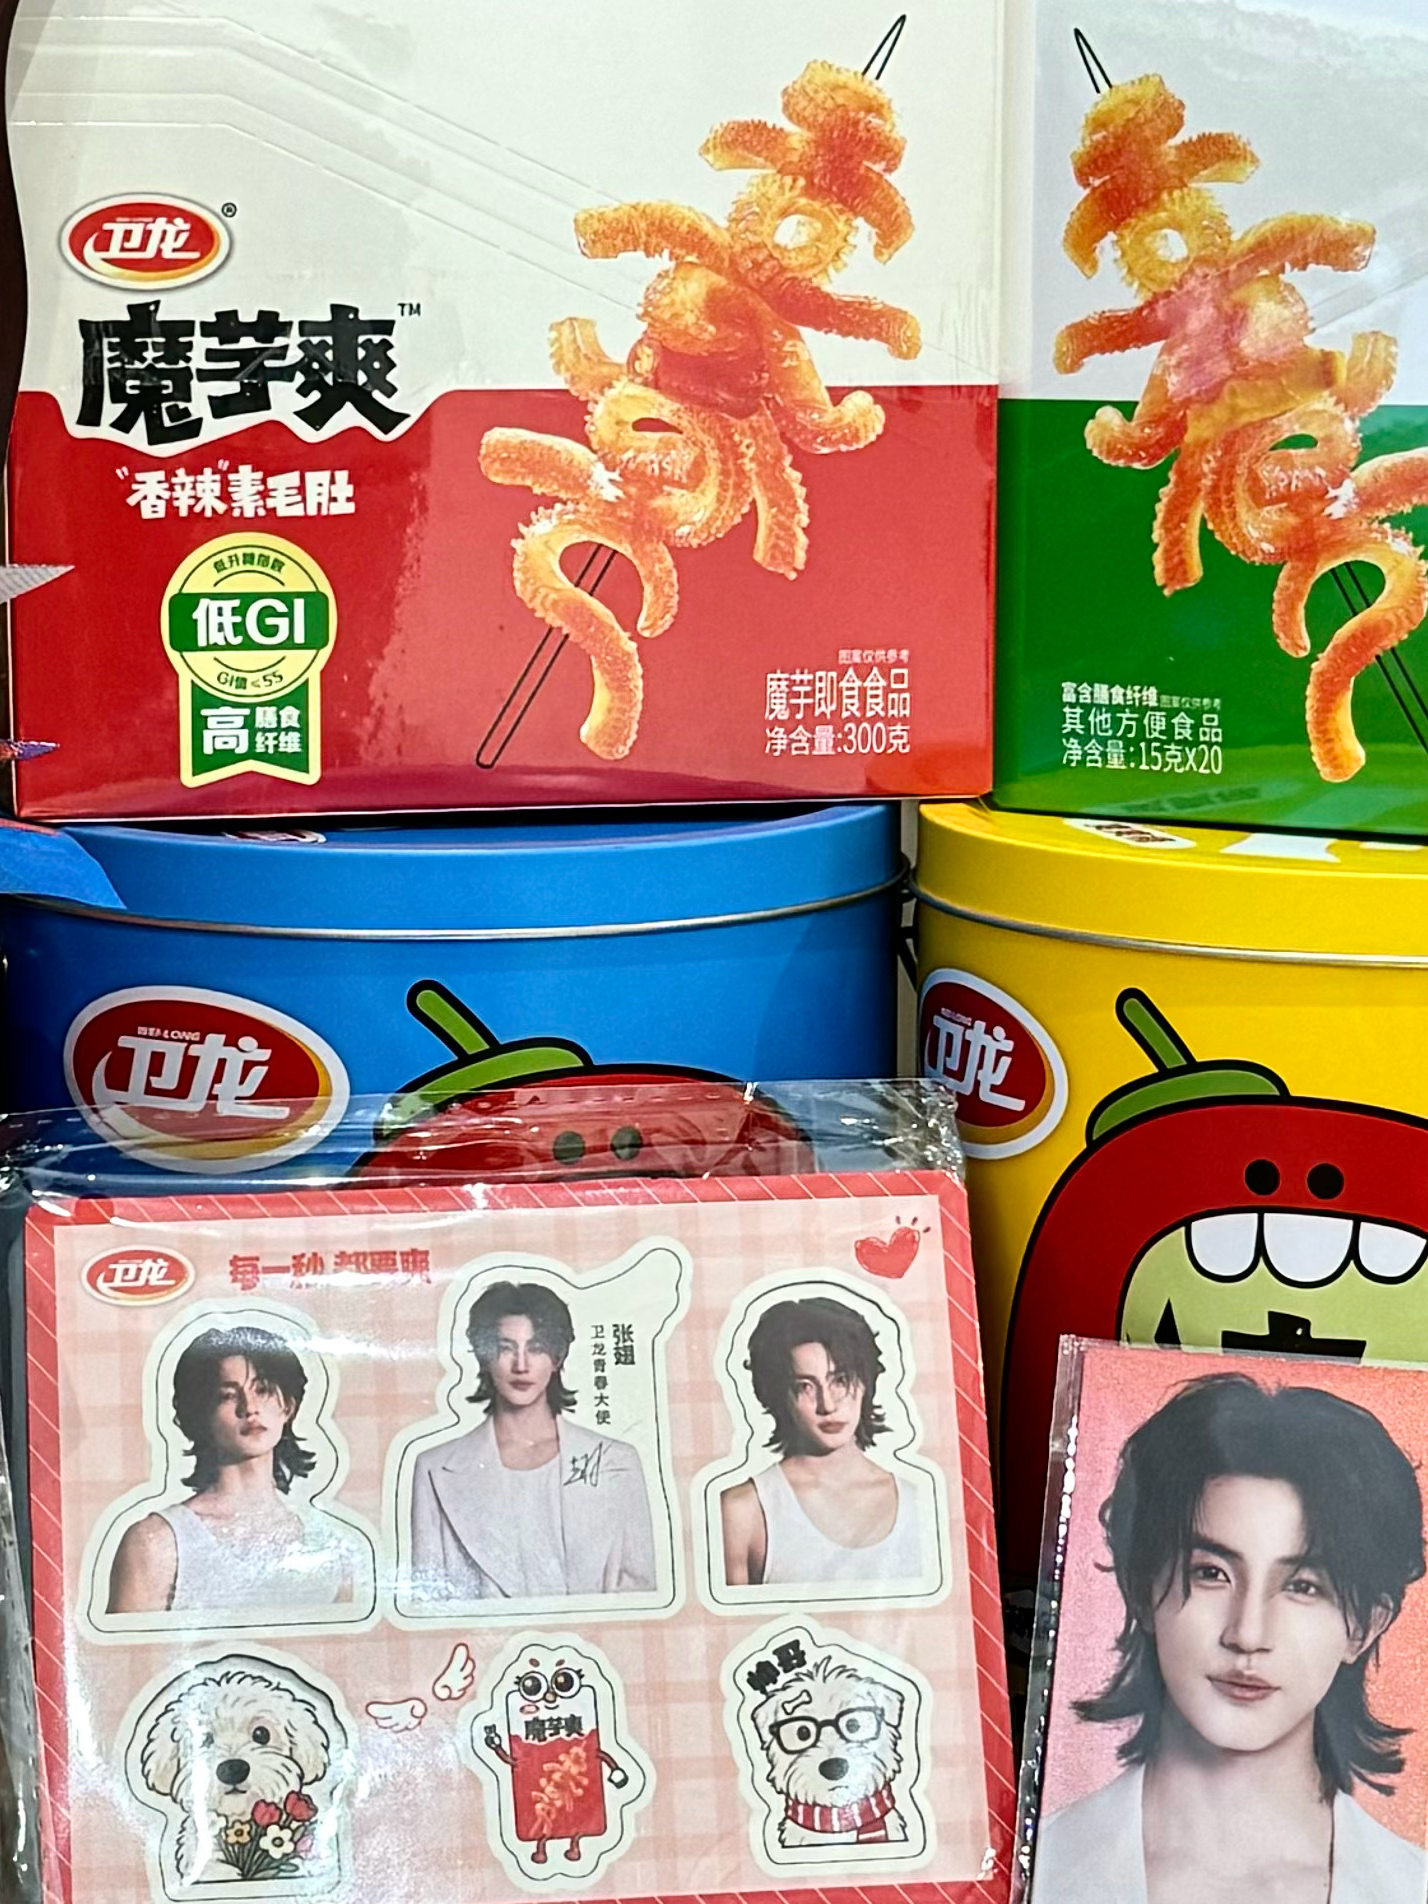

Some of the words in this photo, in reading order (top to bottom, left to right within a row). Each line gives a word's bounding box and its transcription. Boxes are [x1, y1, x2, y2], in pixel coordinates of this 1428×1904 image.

[93, 215, 201, 261] 卫龙
[75, 299, 411, 446] 魔芋爽
[398, 303, 422, 317] TM
[192, 598, 306, 647] 低GI
[765, 666, 911, 721] 魔芋即食食品
[1061, 681, 1159, 708] 富含膳食纤维
[200, 706, 251, 755] 高
[255, 705, 301, 730] 膳食
[1061, 706, 1223, 743] 其他方便食品
[255, 731, 303, 754] 纤维
[118, 1032, 290, 1120] 卫龙
[933, 1015, 1026, 1112] 卫龙
[105, 1258, 176, 1288] 卫龙
